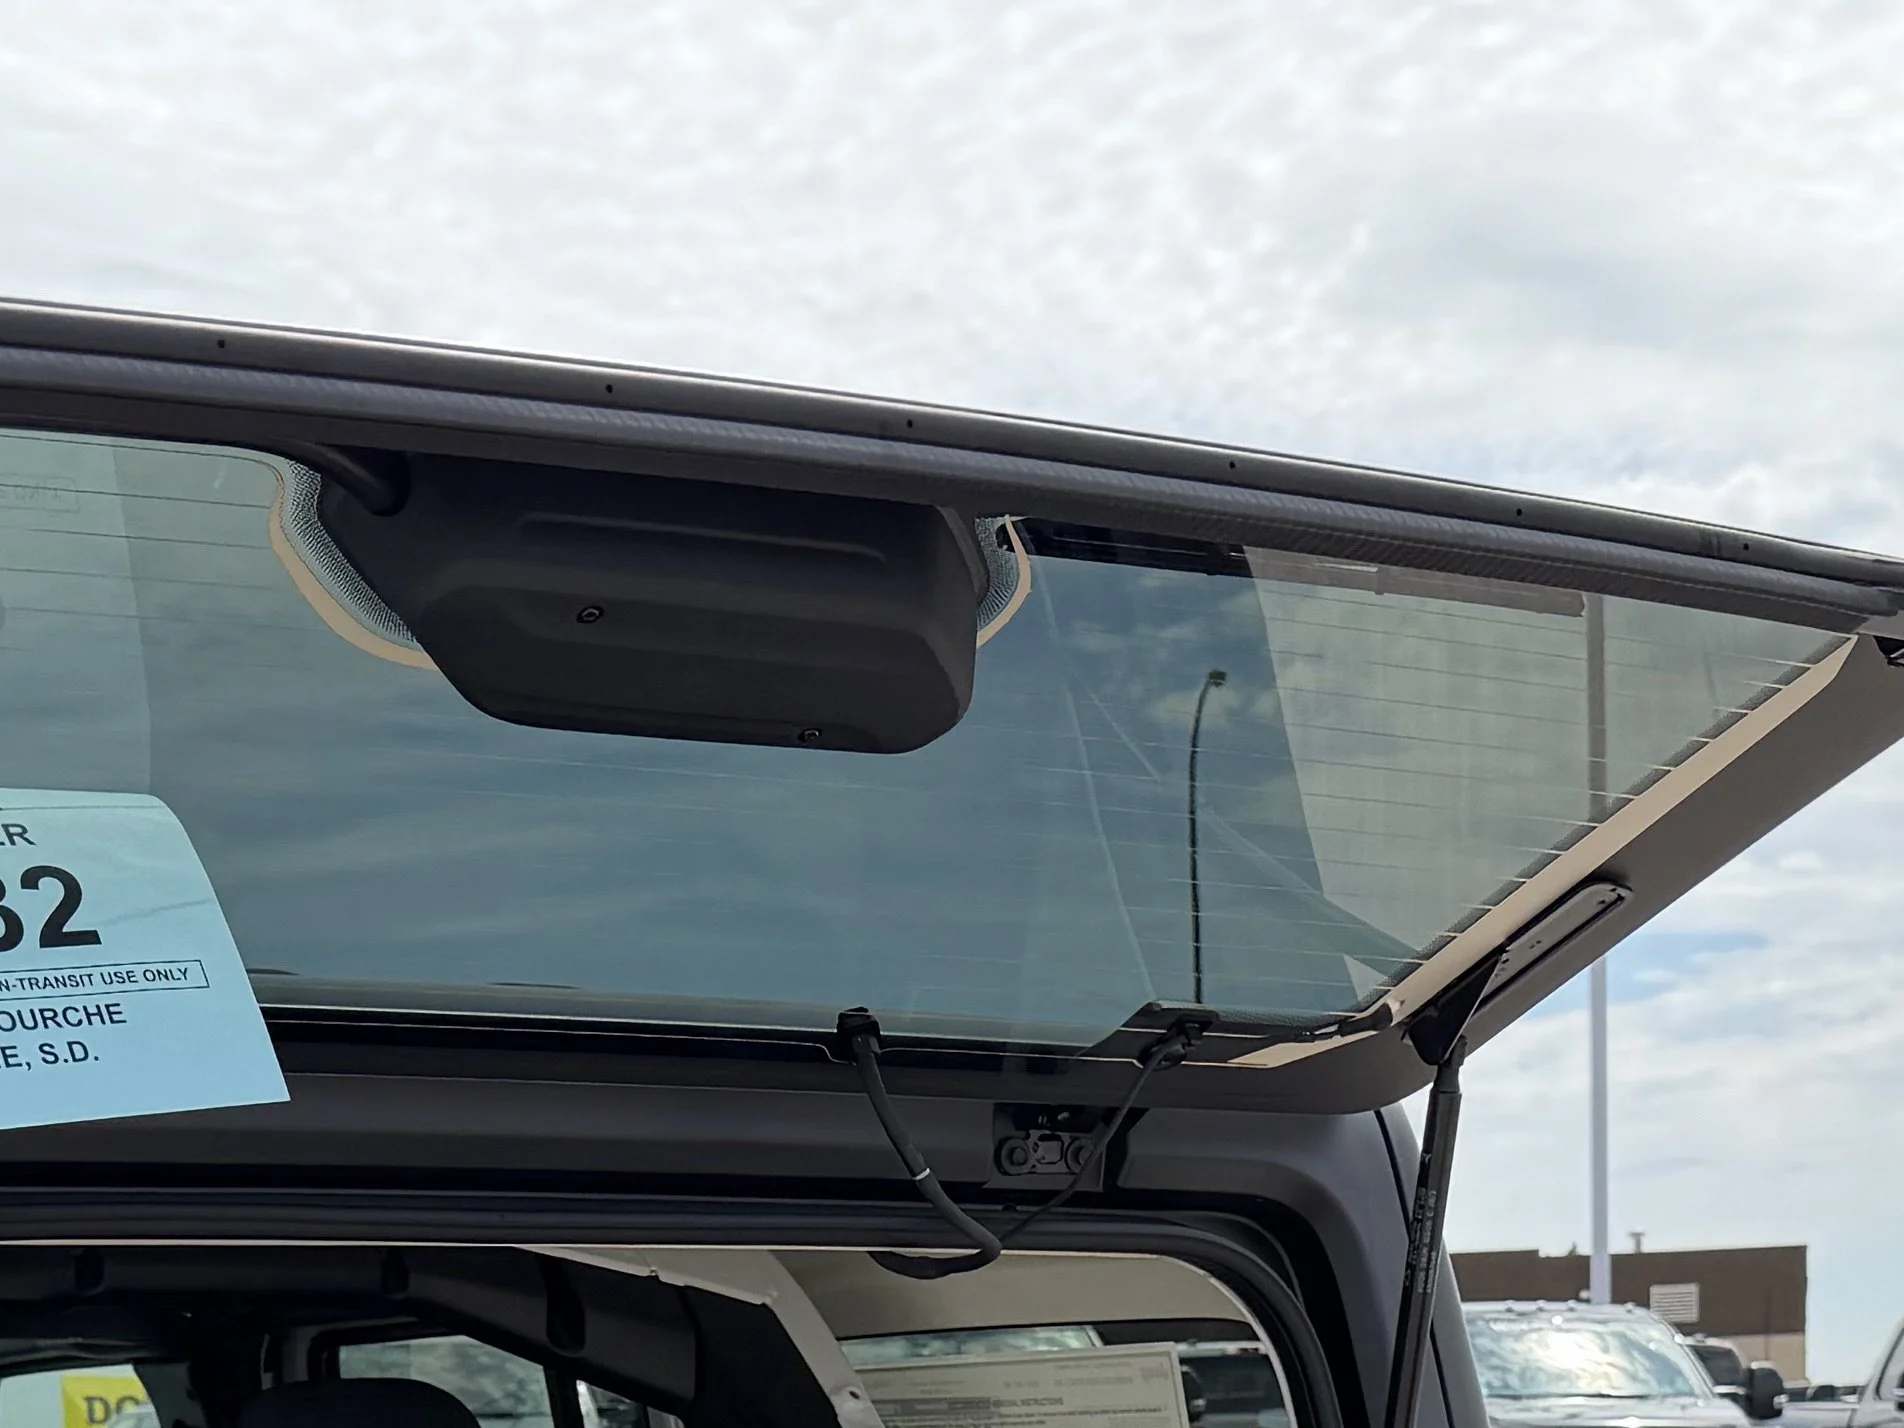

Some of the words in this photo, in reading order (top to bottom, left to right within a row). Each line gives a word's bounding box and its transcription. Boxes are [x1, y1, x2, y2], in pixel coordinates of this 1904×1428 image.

[100, 970, 139, 986] USE
[143, 967, 189, 983] ONLY
[39, 1040, 100, 1065] S.D.
